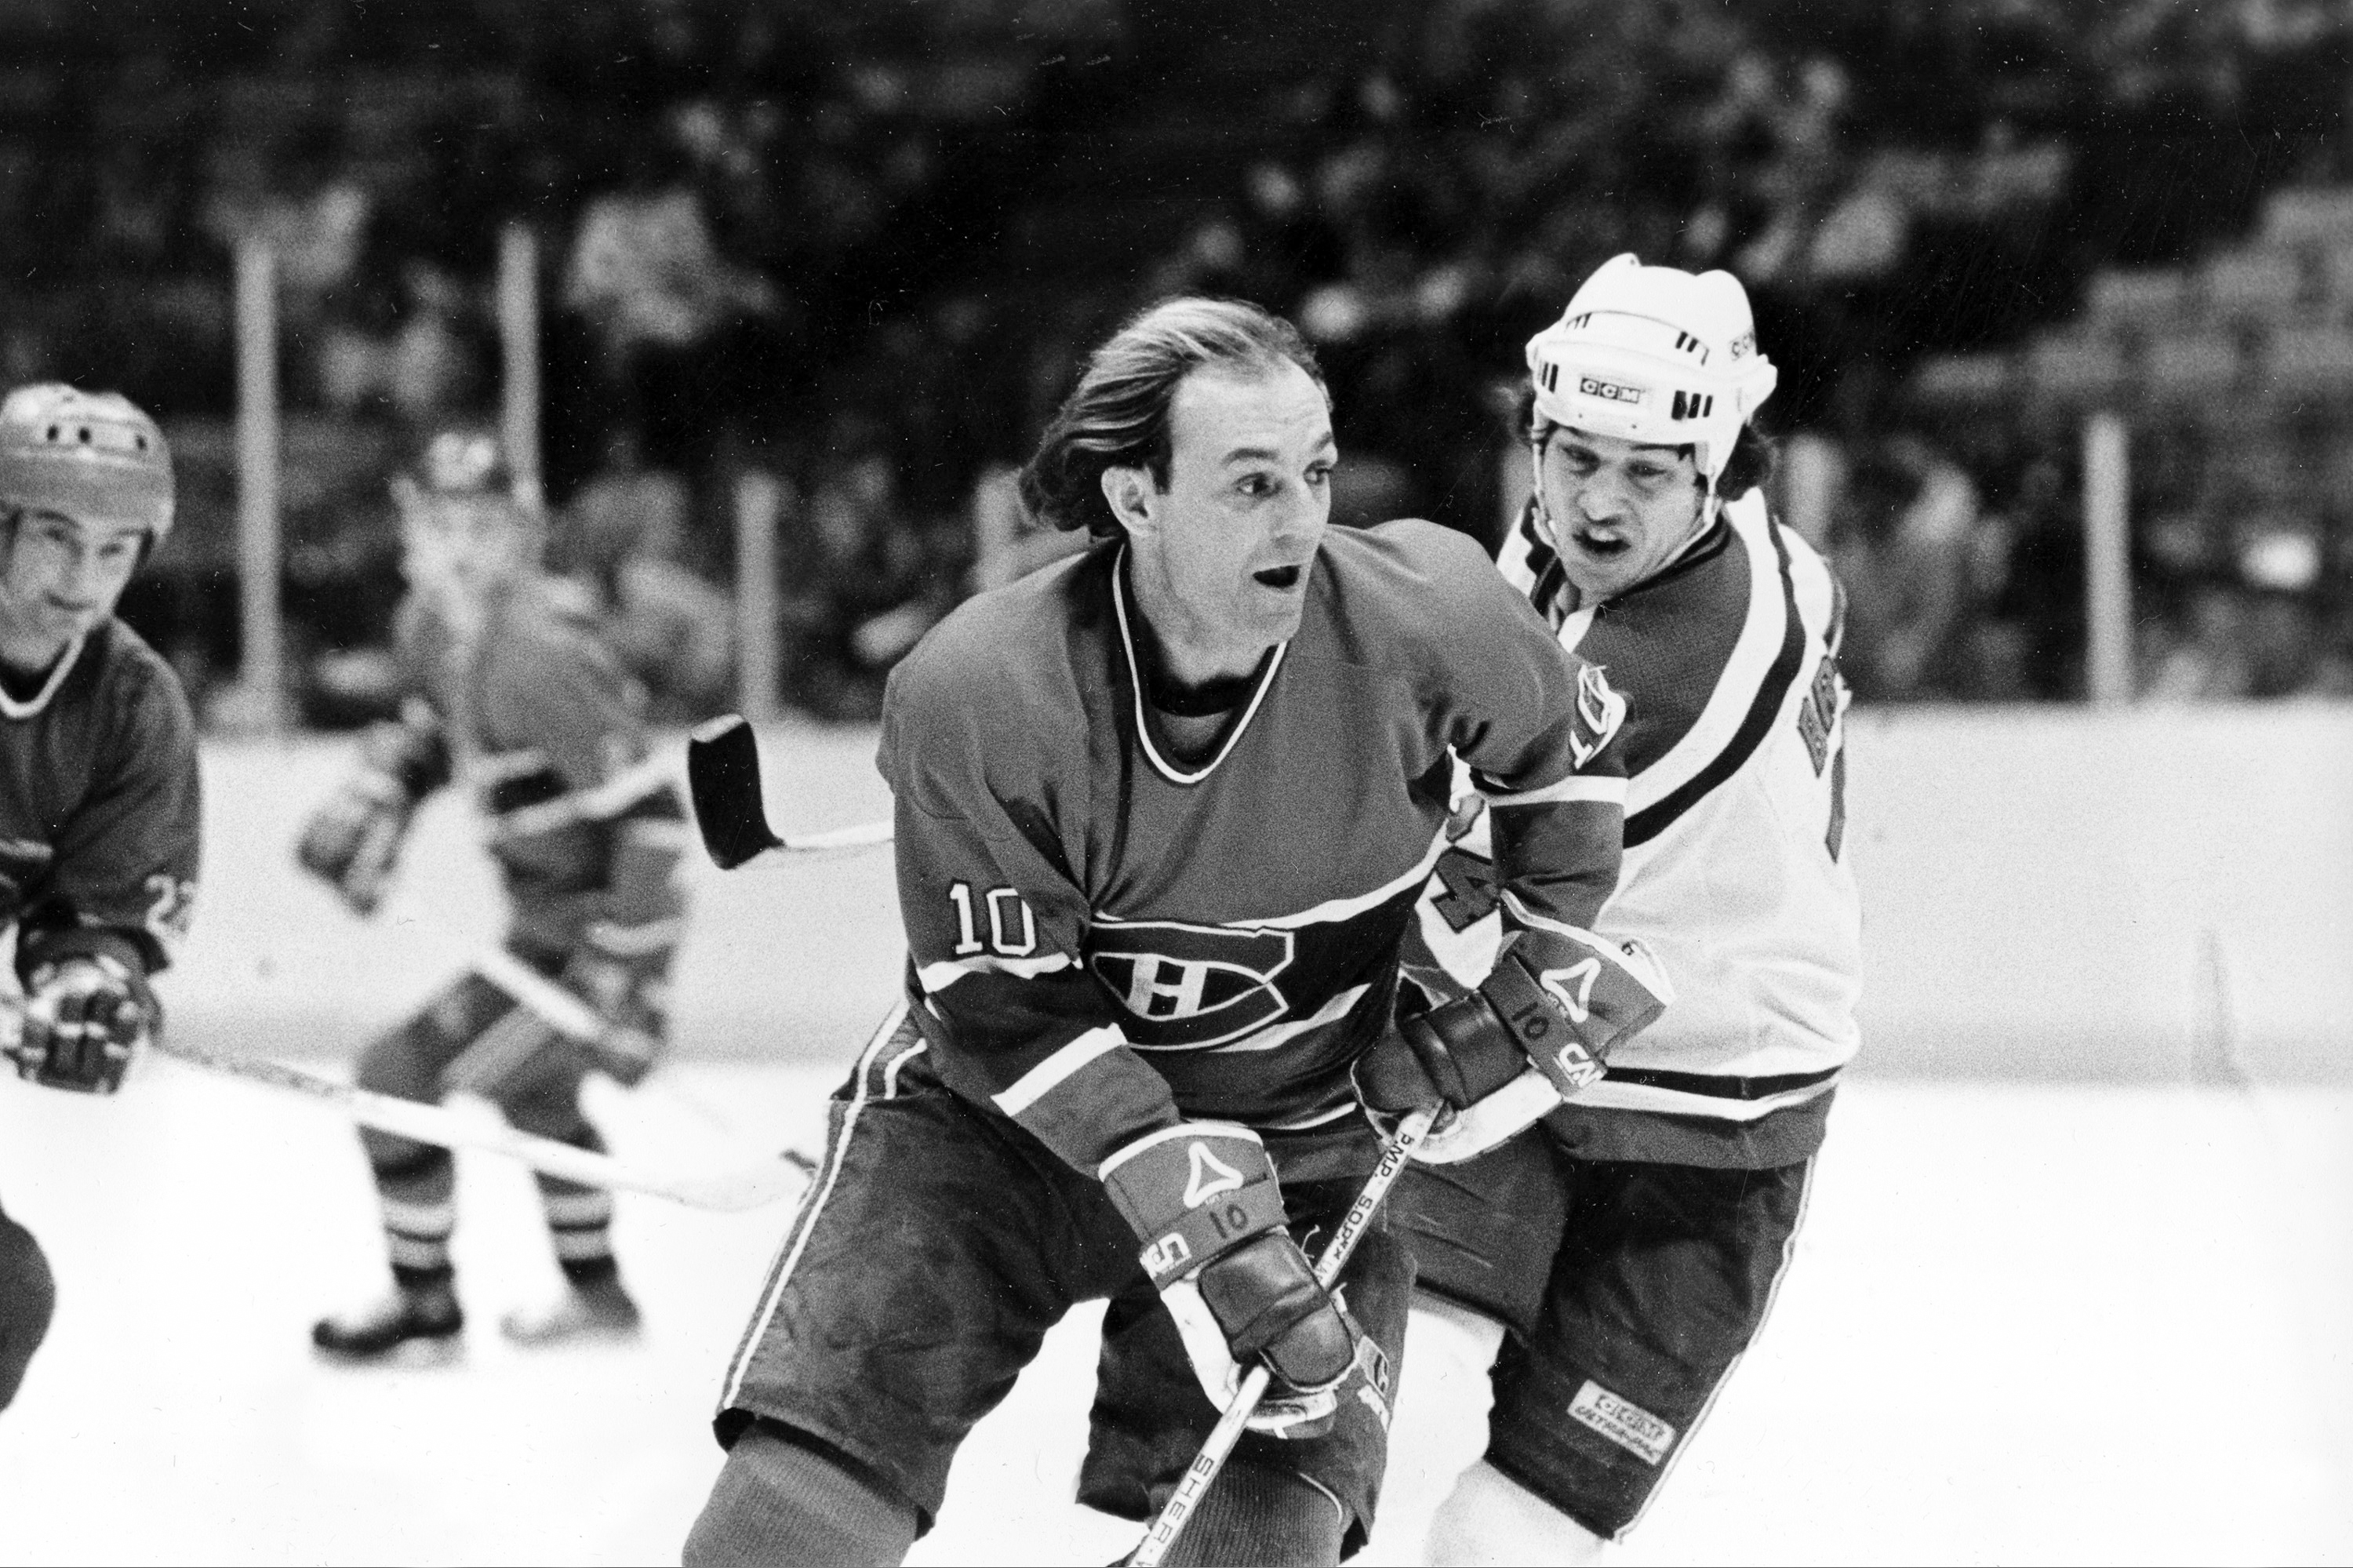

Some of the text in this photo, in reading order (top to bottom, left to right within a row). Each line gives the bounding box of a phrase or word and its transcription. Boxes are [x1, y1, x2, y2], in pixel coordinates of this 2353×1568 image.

[1580, 377, 1640, 403] CCM
[949, 883, 1036, 957] 10
[1511, 1001, 1550, 1040] 10
[1209, 1203, 1249, 1239] 10
